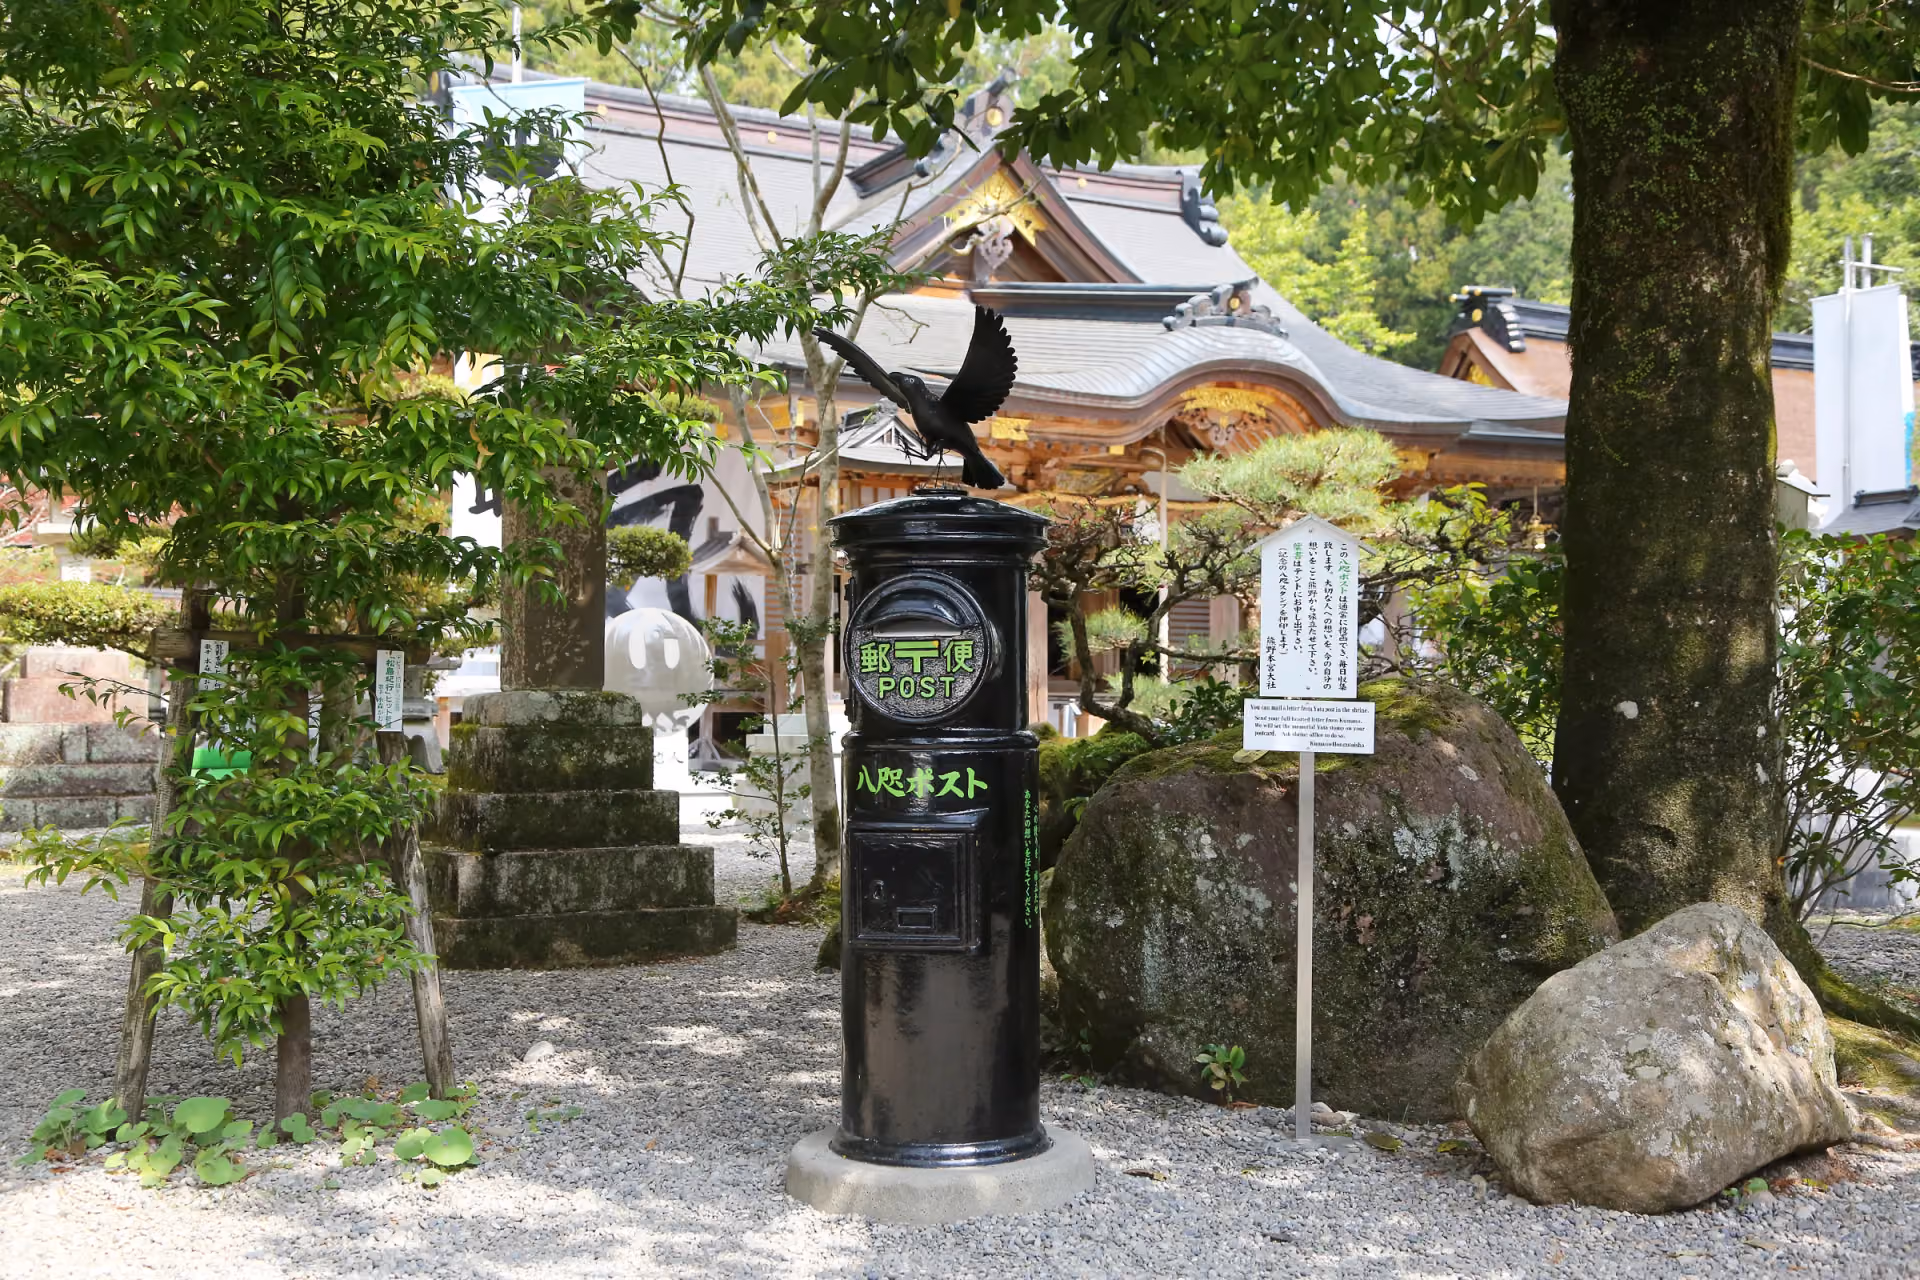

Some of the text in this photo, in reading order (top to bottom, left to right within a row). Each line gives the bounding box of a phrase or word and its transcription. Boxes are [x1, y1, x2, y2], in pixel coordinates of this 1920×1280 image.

[1265, 636, 1277, 690] 熊野本宮大社
[878, 676, 956, 699] POST
[856, 765, 988, 800] 八咫ポスト
